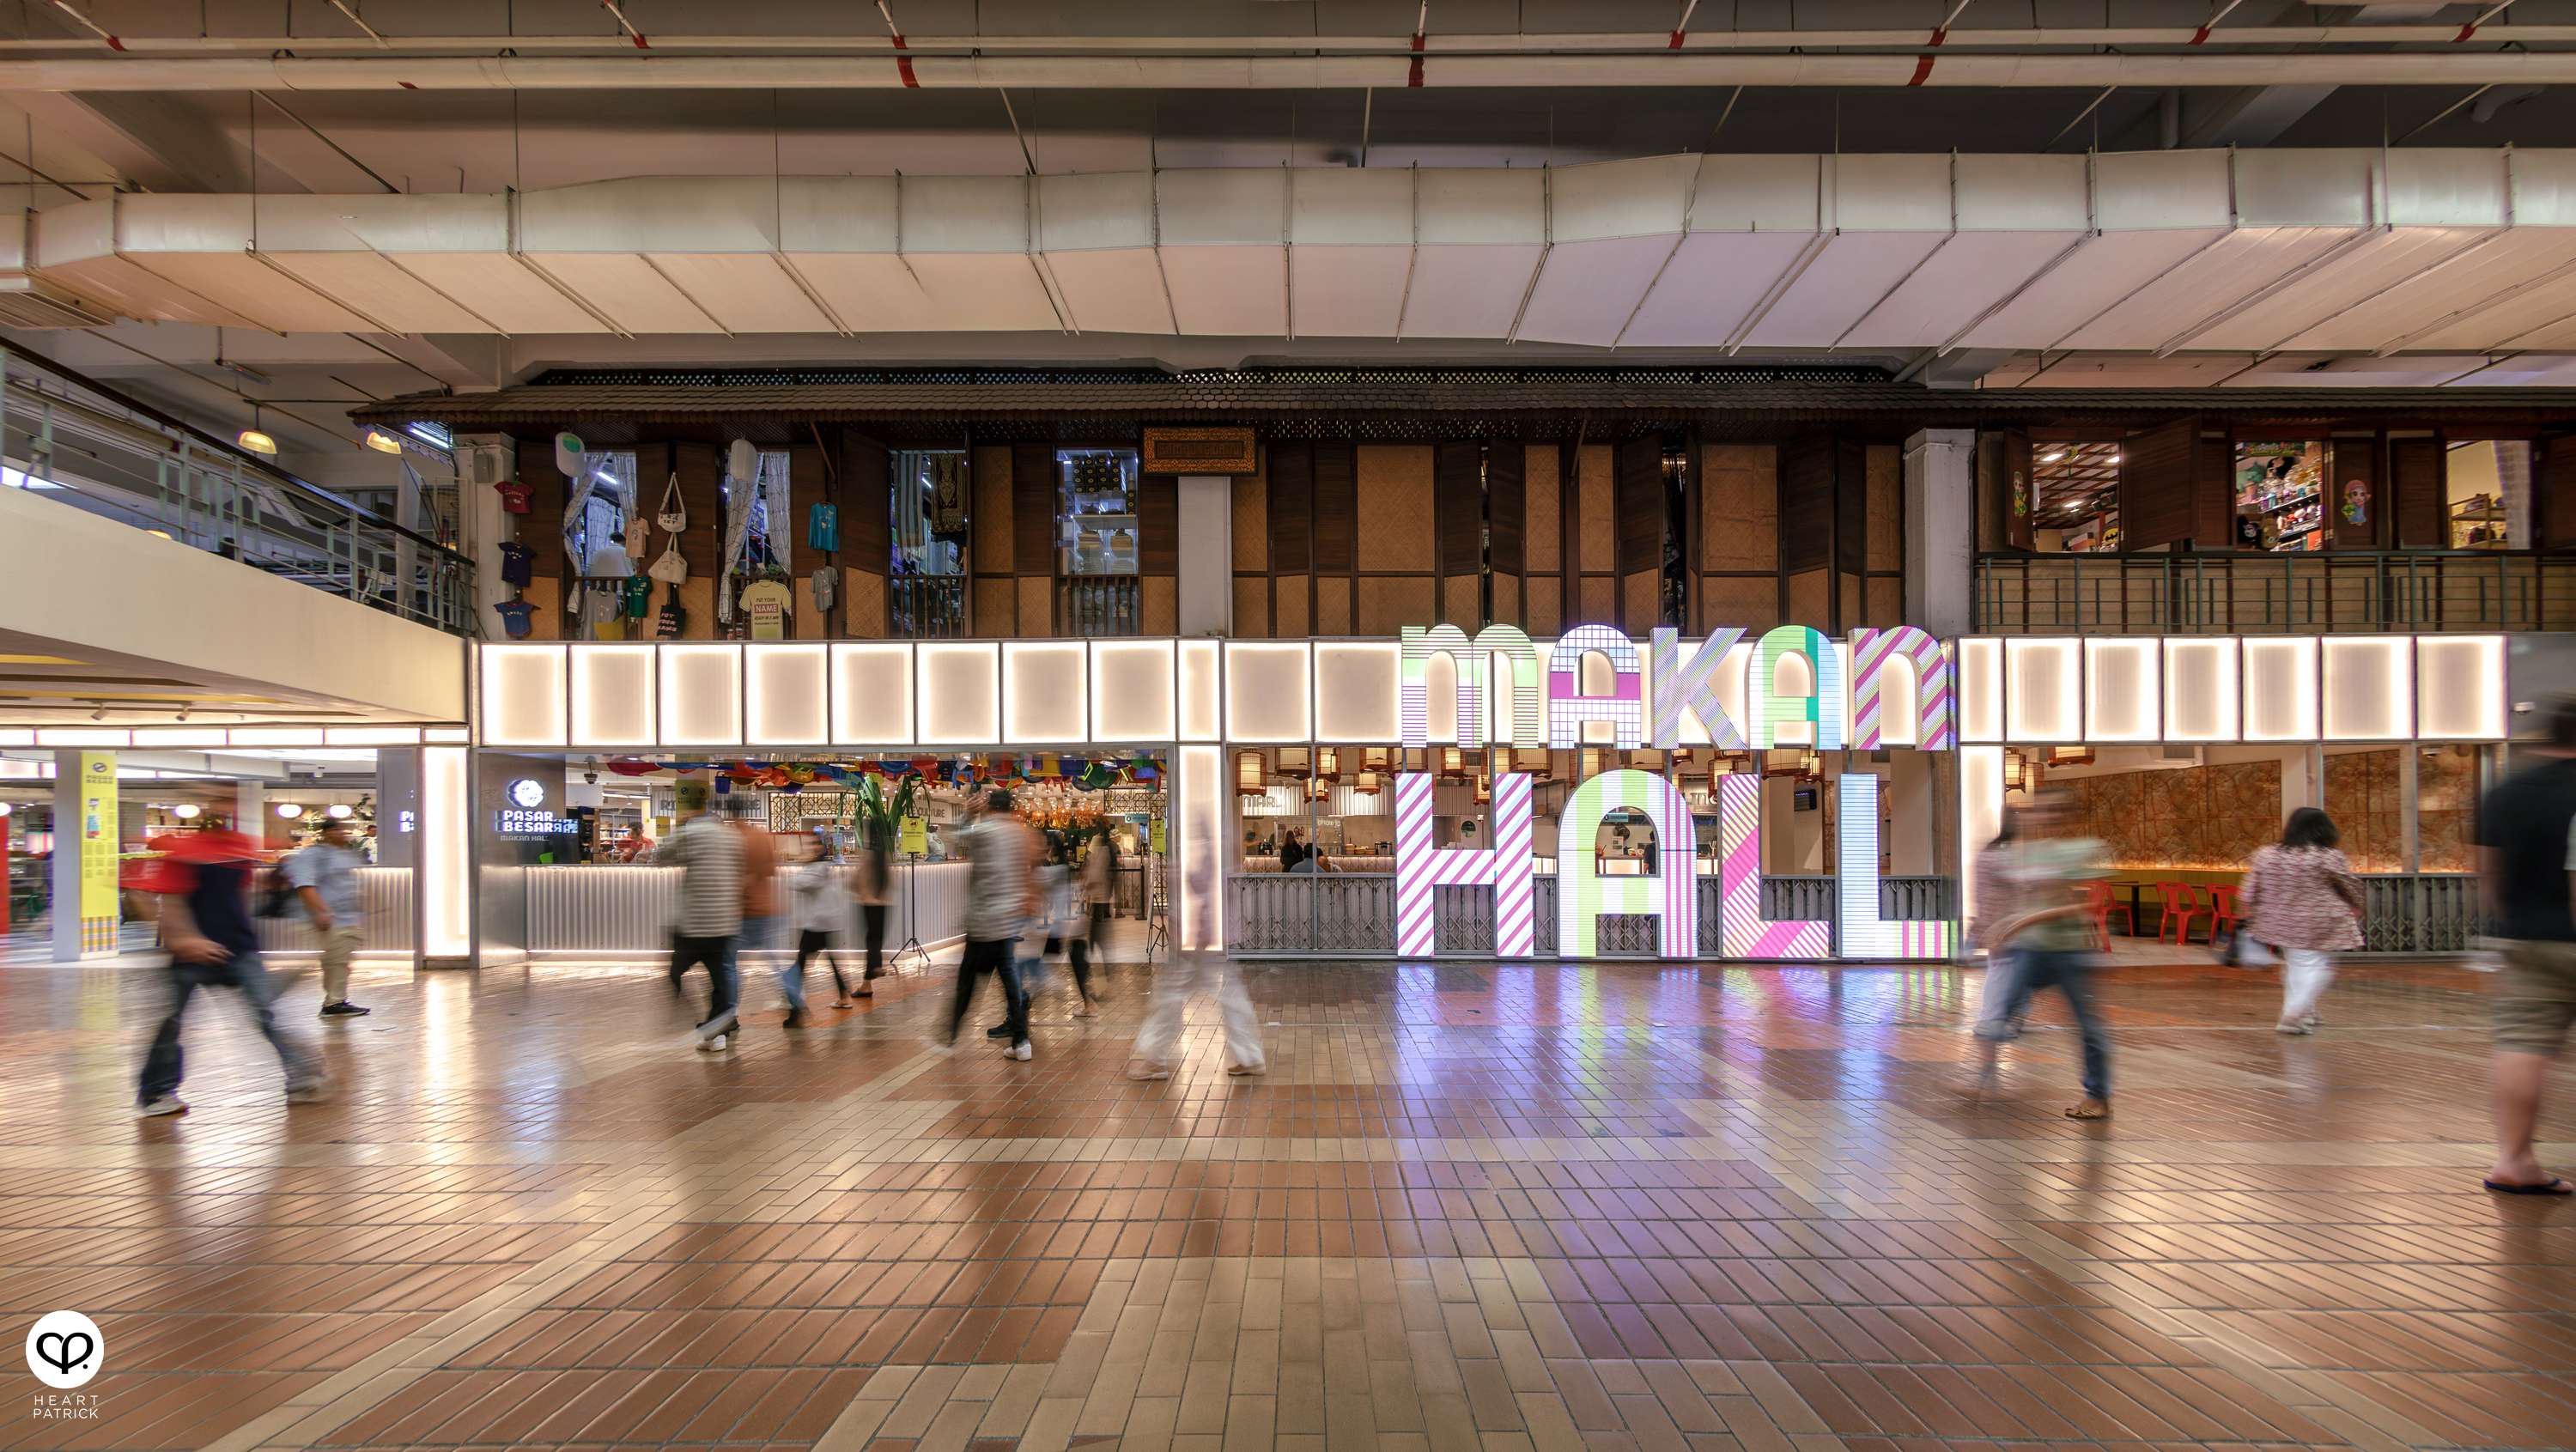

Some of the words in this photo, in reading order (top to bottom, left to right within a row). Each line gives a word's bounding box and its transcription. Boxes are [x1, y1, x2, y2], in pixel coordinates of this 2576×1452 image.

[1400, 623, 1951, 751] MAKAN
[502, 810, 554, 822] PASAR
[502, 821, 554, 833] BESAR
[1395, 769, 1951, 959] HALL
